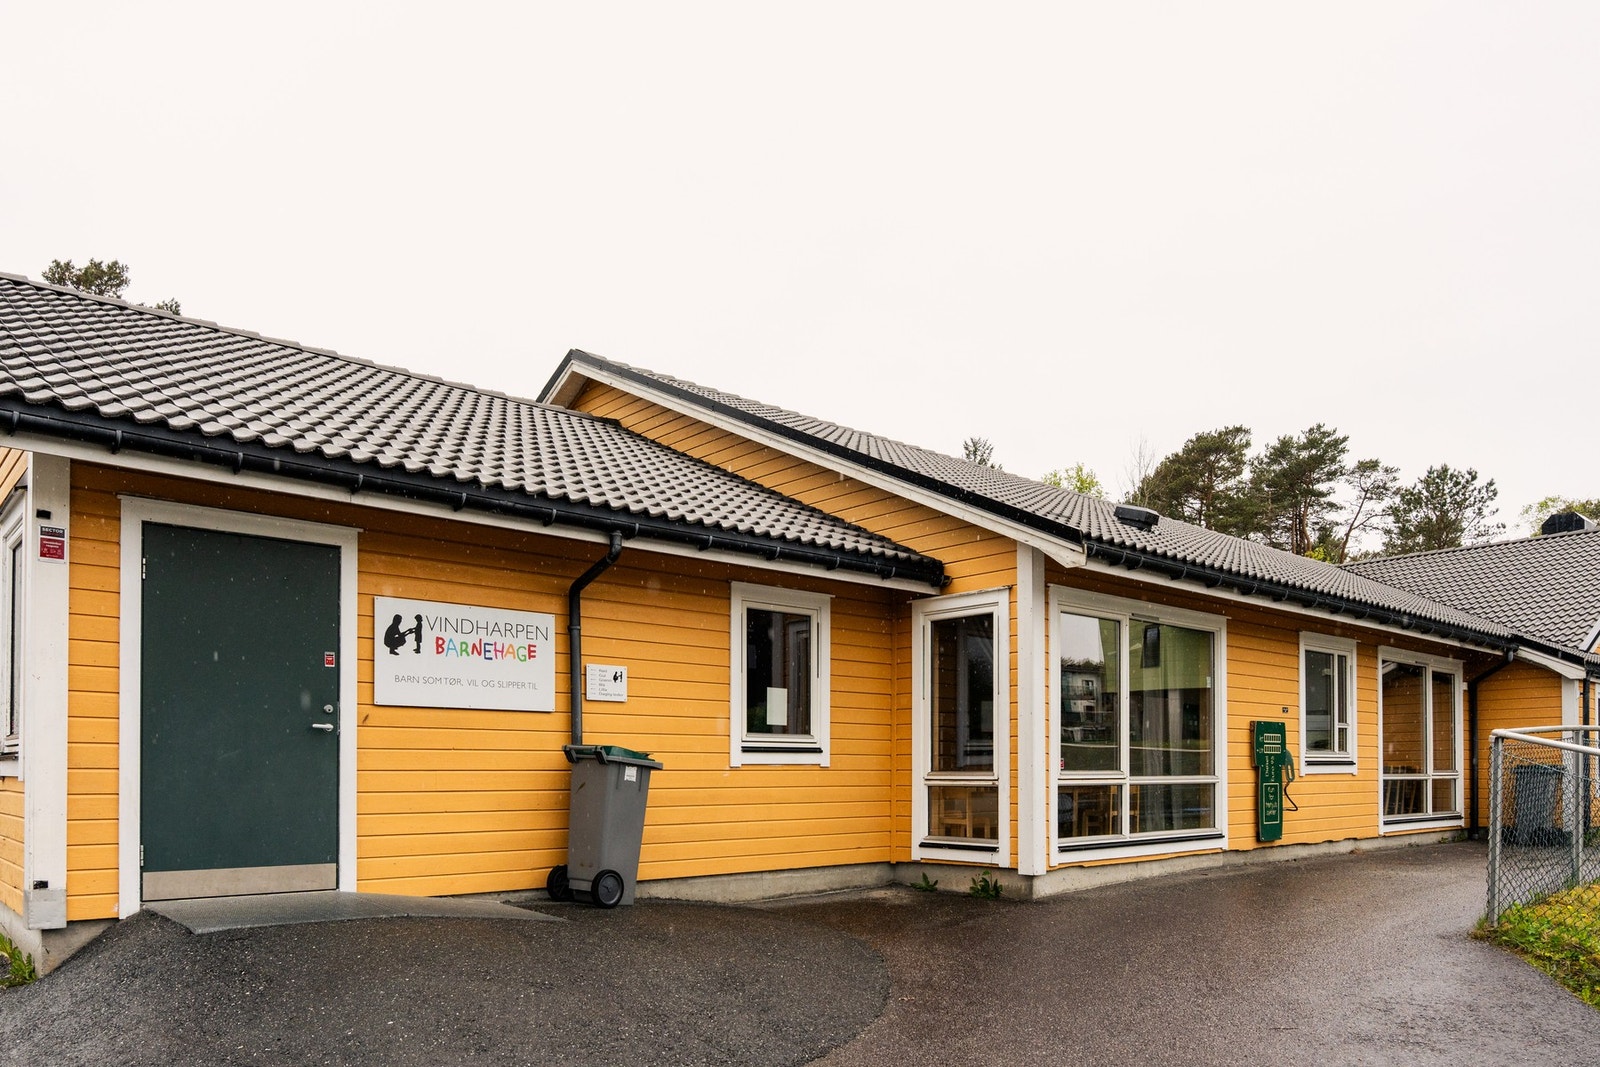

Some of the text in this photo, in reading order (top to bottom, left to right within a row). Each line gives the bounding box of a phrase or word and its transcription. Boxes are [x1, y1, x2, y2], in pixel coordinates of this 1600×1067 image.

[425, 614, 549, 641] VINDHARPEN
[435, 636, 537, 662] BARNEHAGE
[394, 674, 420, 684] BARN
[422, 675, 442, 685] SOM
[467, 679, 479, 687] VIL
[481, 679, 495, 688] OG
[497, 680, 526, 690] SLIPPER
[527, 682, 539, 690] TIL
